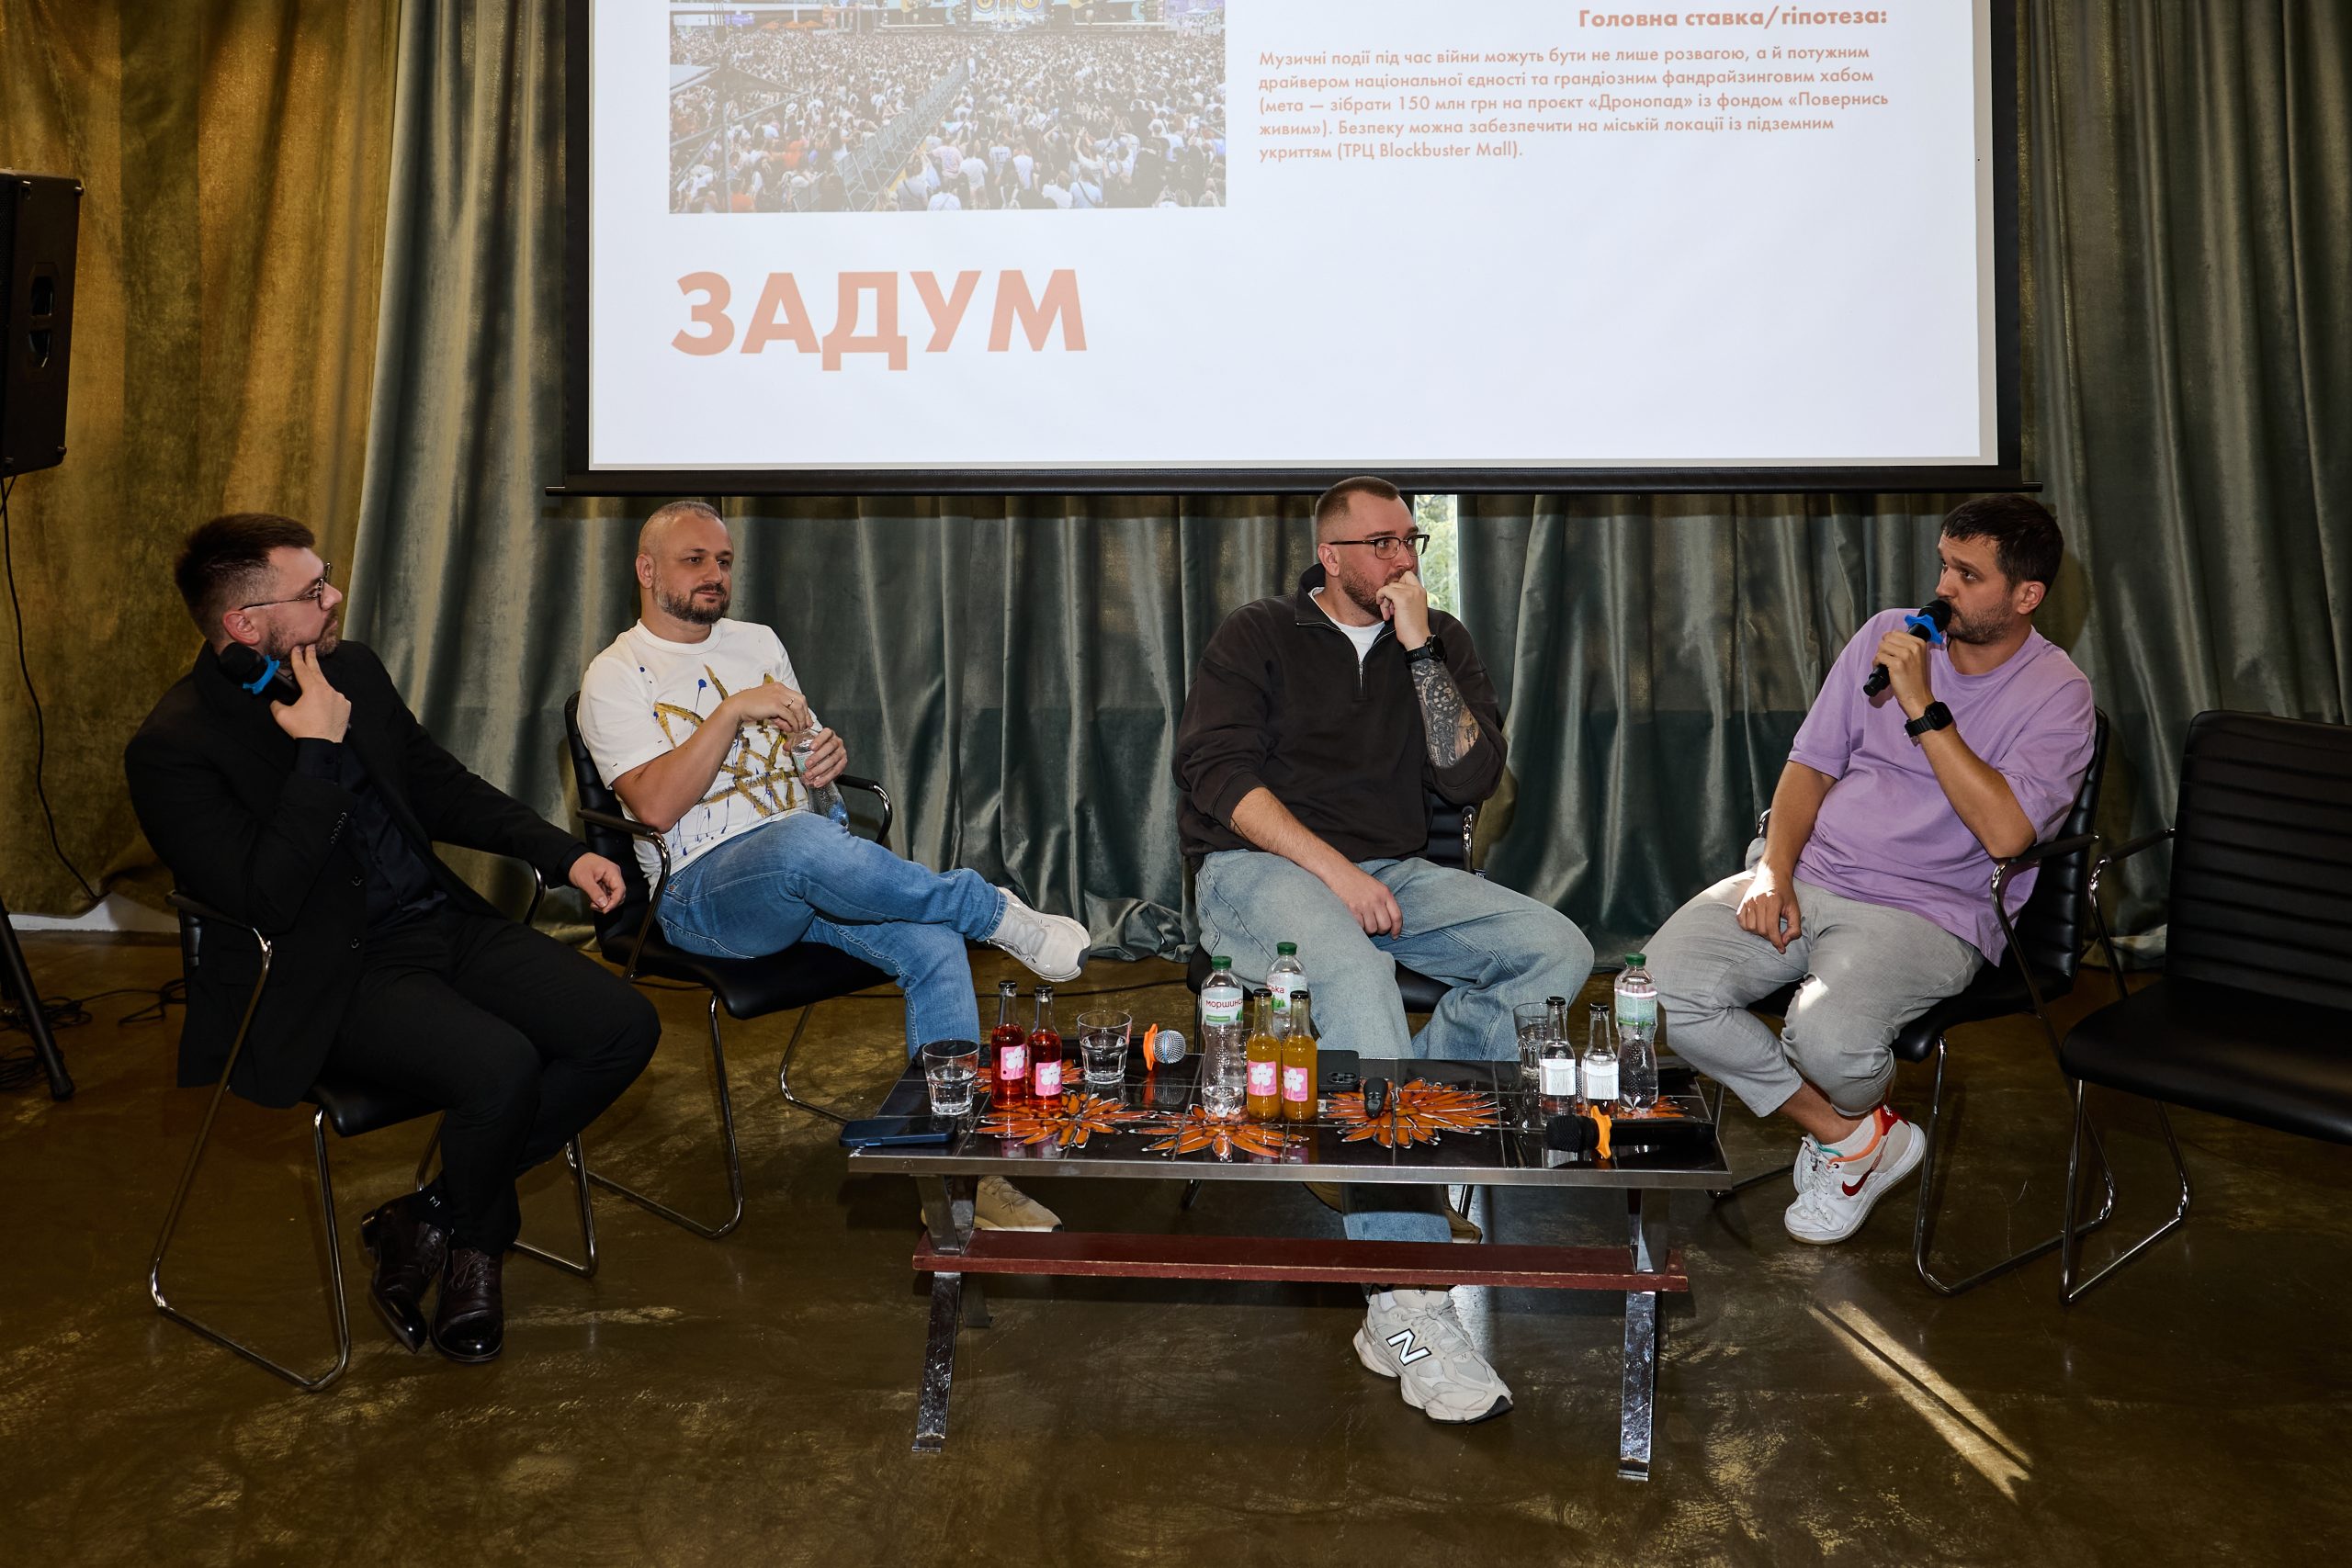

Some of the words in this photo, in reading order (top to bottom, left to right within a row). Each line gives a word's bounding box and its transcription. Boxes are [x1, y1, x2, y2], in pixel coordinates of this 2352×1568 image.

[1578, 8, 1679, 28] Головна
[1685, 5, 1888, 29] ставка/гіпотеза:
[1259, 51, 1327, 69] Музичні
[1331, 50, 1371, 67] події
[1375, 51, 1400, 67] під
[1404, 52, 1431, 64] час
[1436, 50, 1480, 64] війни
[1484, 51, 1544, 66] можуть
[1548, 47, 1587, 65] бути
[1591, 51, 1611, 62] не
[1615, 50, 1659, 62] лише
[1664, 48, 1750, 64] розвагою,
[1756, 49, 1767, 61] а
[1771, 46, 1782, 60] й
[1787, 48, 1871, 63] потужним
[1259, 74, 1350, 92] драйвером
[1354, 73, 1463, 90] національної
[1466, 72, 1526, 89] єдності
[1531, 74, 1549, 86] та
[1554, 71, 1658, 89] грандіозним
[1662, 69, 1815, 88] фандрайзинговим
[1819, 67, 1874, 83] хабом
[1259, 96, 1304, 115] (мета
[1330, 96, 1392, 116] зібрати
[1399, 96, 1430, 110] 150
[1435, 98, 1465, 110] млн
[1470, 98, 1498, 114] грн
[1502, 97, 1522, 109] на
[1527, 96, 1584, 113] проєкт
[1588, 94, 1693, 112] «Дронопад»
[1698, 94, 1712, 107] із
[1716, 93, 1783, 111] фондом
[1788, 91, 1889, 110] «Повернись
[1259, 119, 1333, 138] живим»).
[1338, 119, 1405, 138] Безпеку
[1408, 121, 1464, 134] можна
[1468, 118, 1574, 133] забезпечити
[1577, 120, 1598, 132] на
[1602, 117, 1659, 132] міській
[1663, 117, 1724, 133] локації
[1728, 116, 1743, 131] із
[1747, 117, 1835, 133] підземним
[1259, 146, 1333, 163] укриттям
[1337, 141, 1376, 162] (ТРЦ
[1379, 141, 1471, 158] Blockbuster
[1476, 140, 1523, 160] Mall).
[671, 268, 1088, 372] ЗАДУМ
[1385, 1328, 1432, 1366] N
